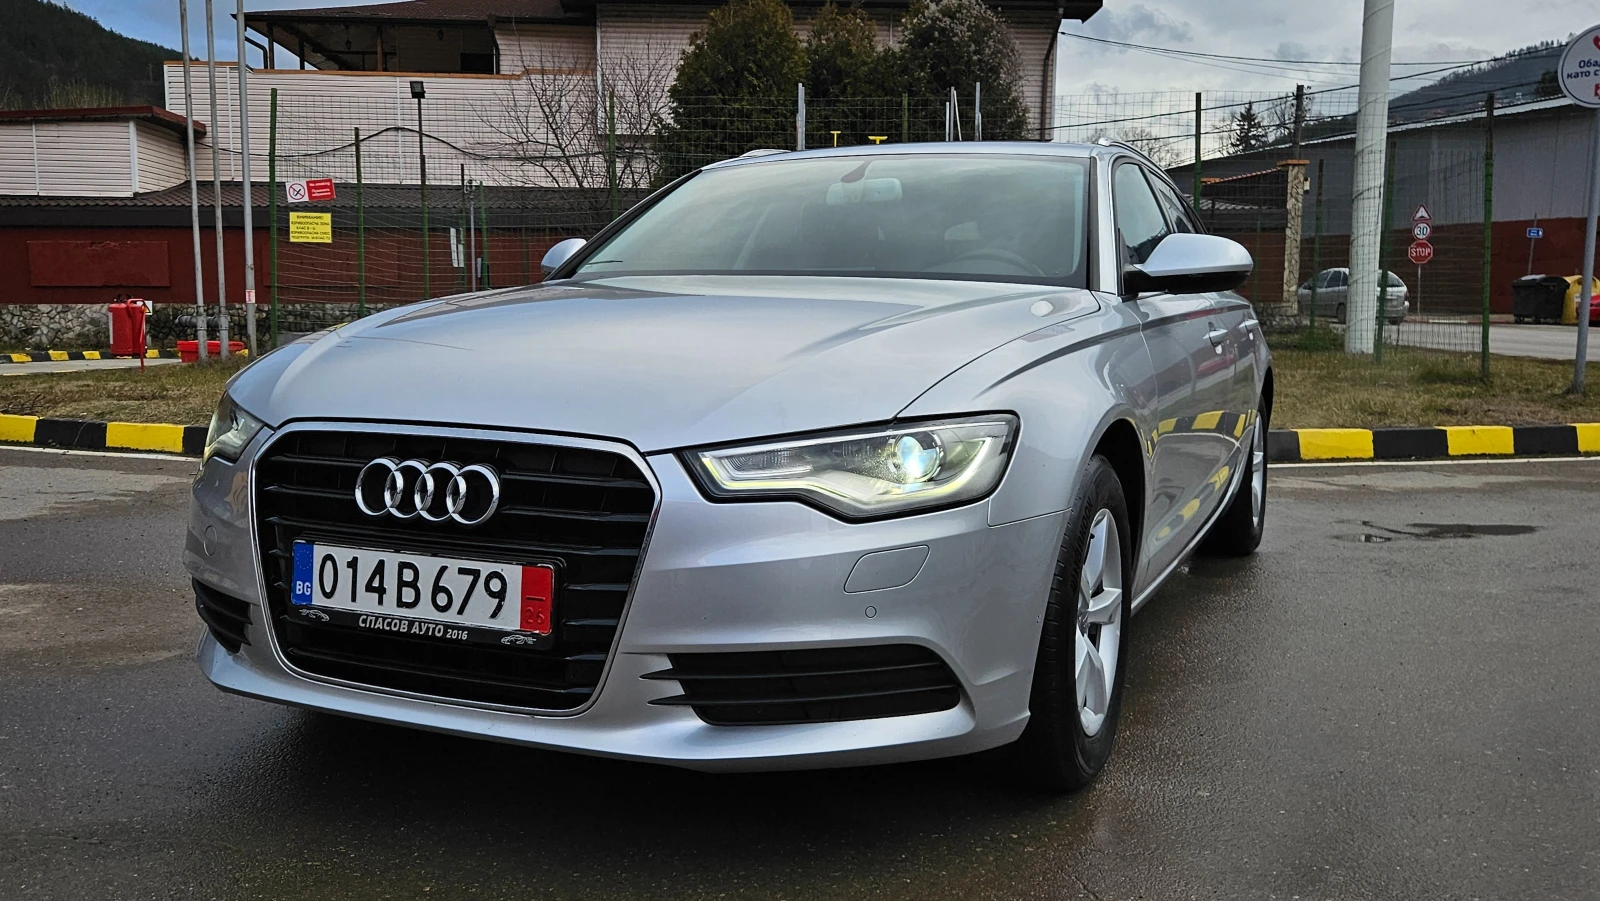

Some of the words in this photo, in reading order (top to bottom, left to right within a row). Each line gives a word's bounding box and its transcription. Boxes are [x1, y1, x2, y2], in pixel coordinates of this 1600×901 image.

[1567, 71, 1590, 79] като
[1416, 226, 1428, 235] 30
[1411, 247, 1431, 257] STOP
[296, 581, 311, 595] BG
[359, 615, 409, 632] СПАСОВ
[410, 621, 444, 637] АУТО
[446, 629, 468, 640] 2016
